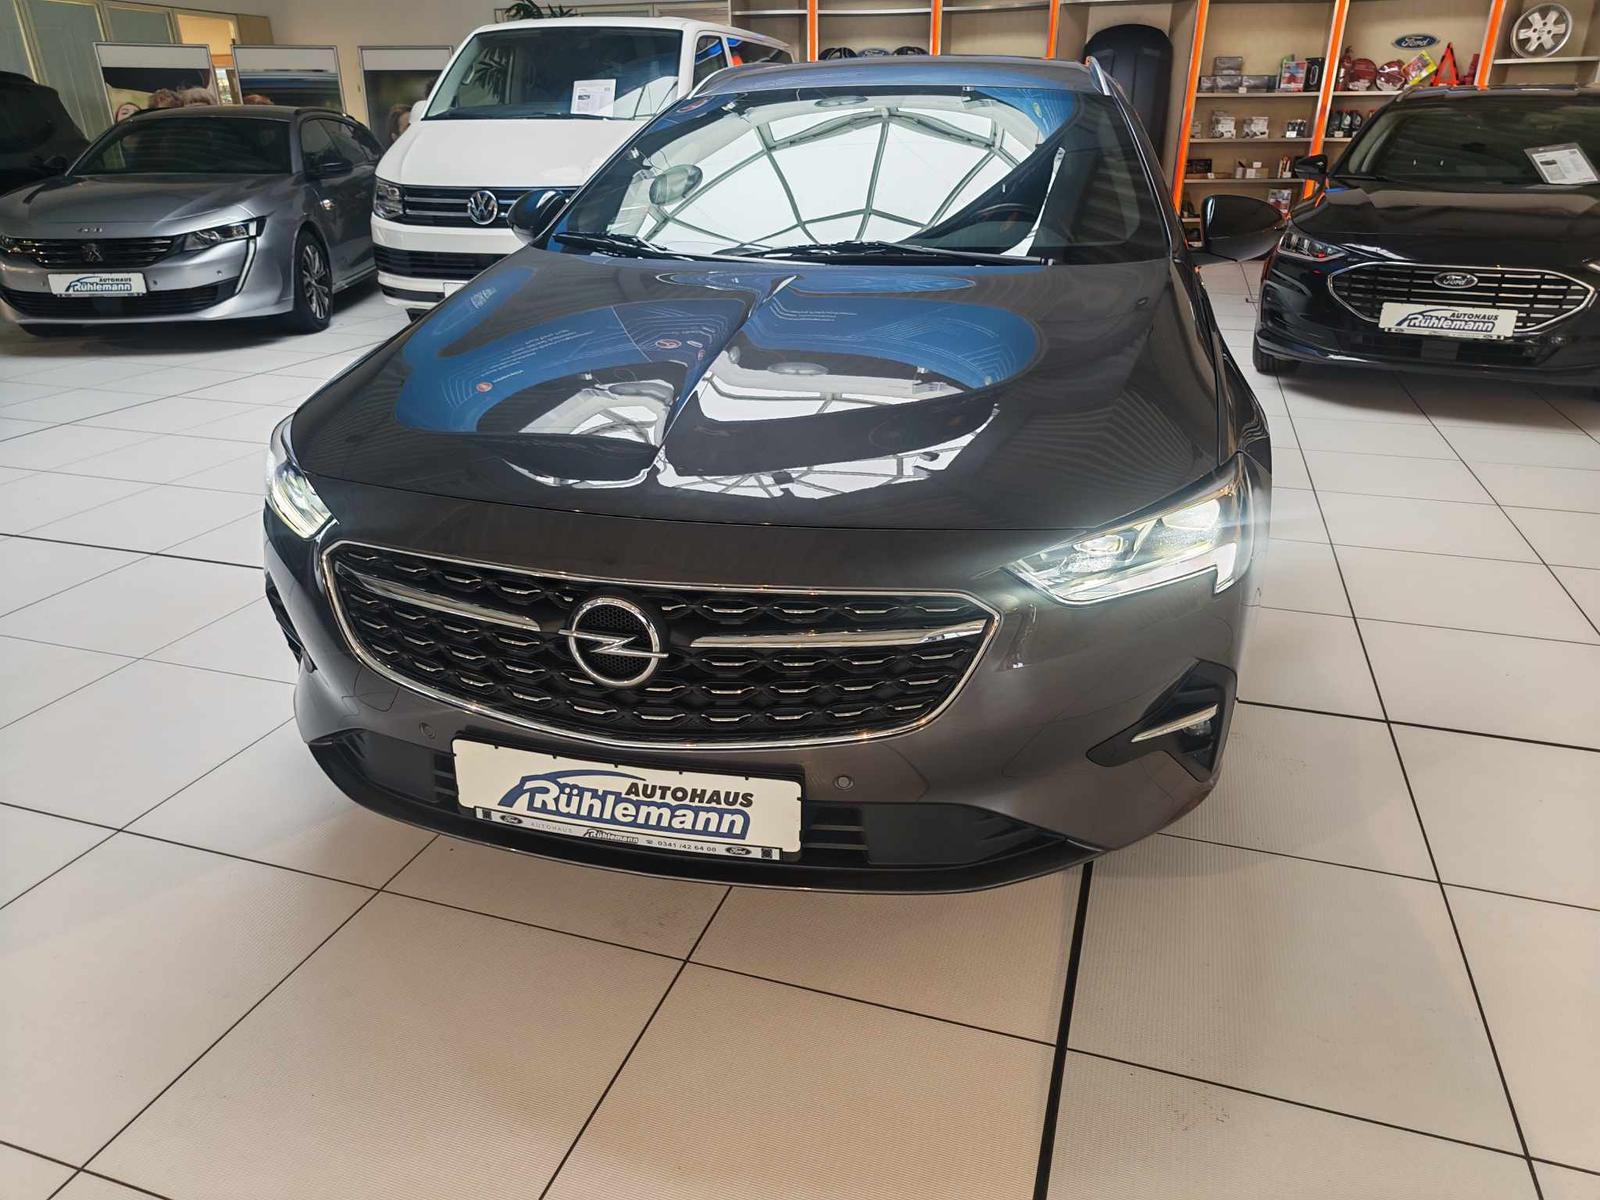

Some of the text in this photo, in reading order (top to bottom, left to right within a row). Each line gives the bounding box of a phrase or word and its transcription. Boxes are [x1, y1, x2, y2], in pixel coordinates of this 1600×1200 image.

[70, 281, 132, 292] Rühlemann
[1407, 314, 1494, 332] Rühlemann
[1449, 312, 1499, 321] AUTOHAUS
[624, 782, 754, 808] AUTOHAUS
[523, 780, 744, 835] Rühlemann
[530, 822, 573, 833] AUTOHAUS
[587, 829, 639, 844] Rühlemann
